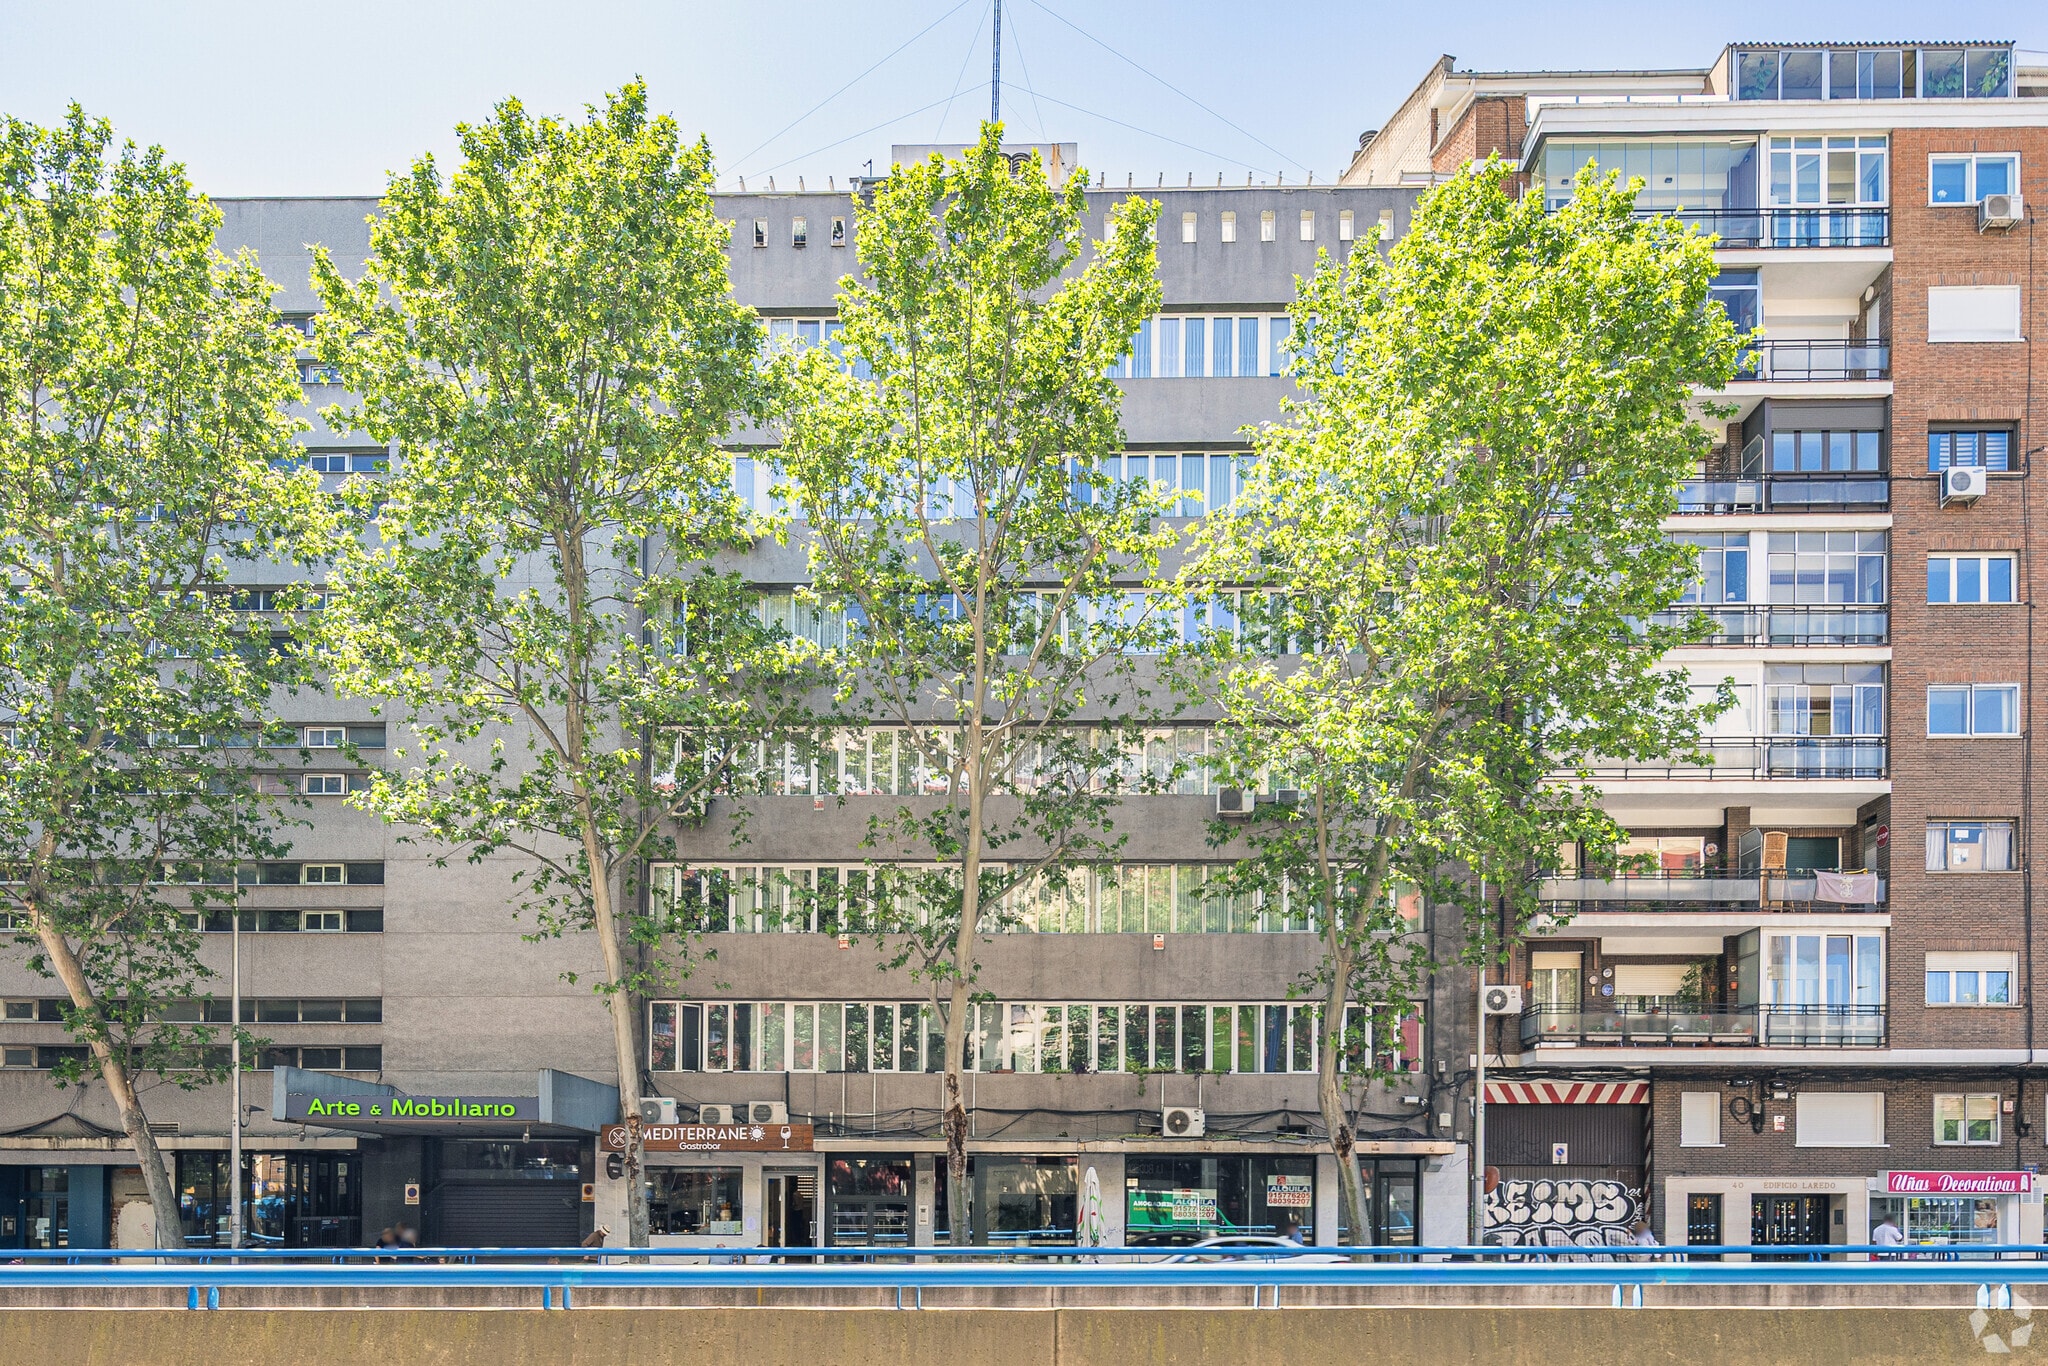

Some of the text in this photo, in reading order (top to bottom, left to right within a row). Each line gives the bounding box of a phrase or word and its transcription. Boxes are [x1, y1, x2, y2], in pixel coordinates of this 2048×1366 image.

[307, 1098, 516, 1118] Arte & Mobiliario
[679, 1141, 721, 1150] Gastrobar
[1731, 1181, 1744, 1189] 40
[1763, 1181, 1836, 1189] EDIFICIO LAREDO
[1891, 1174, 2017, 1192] Uñas Decorativas
